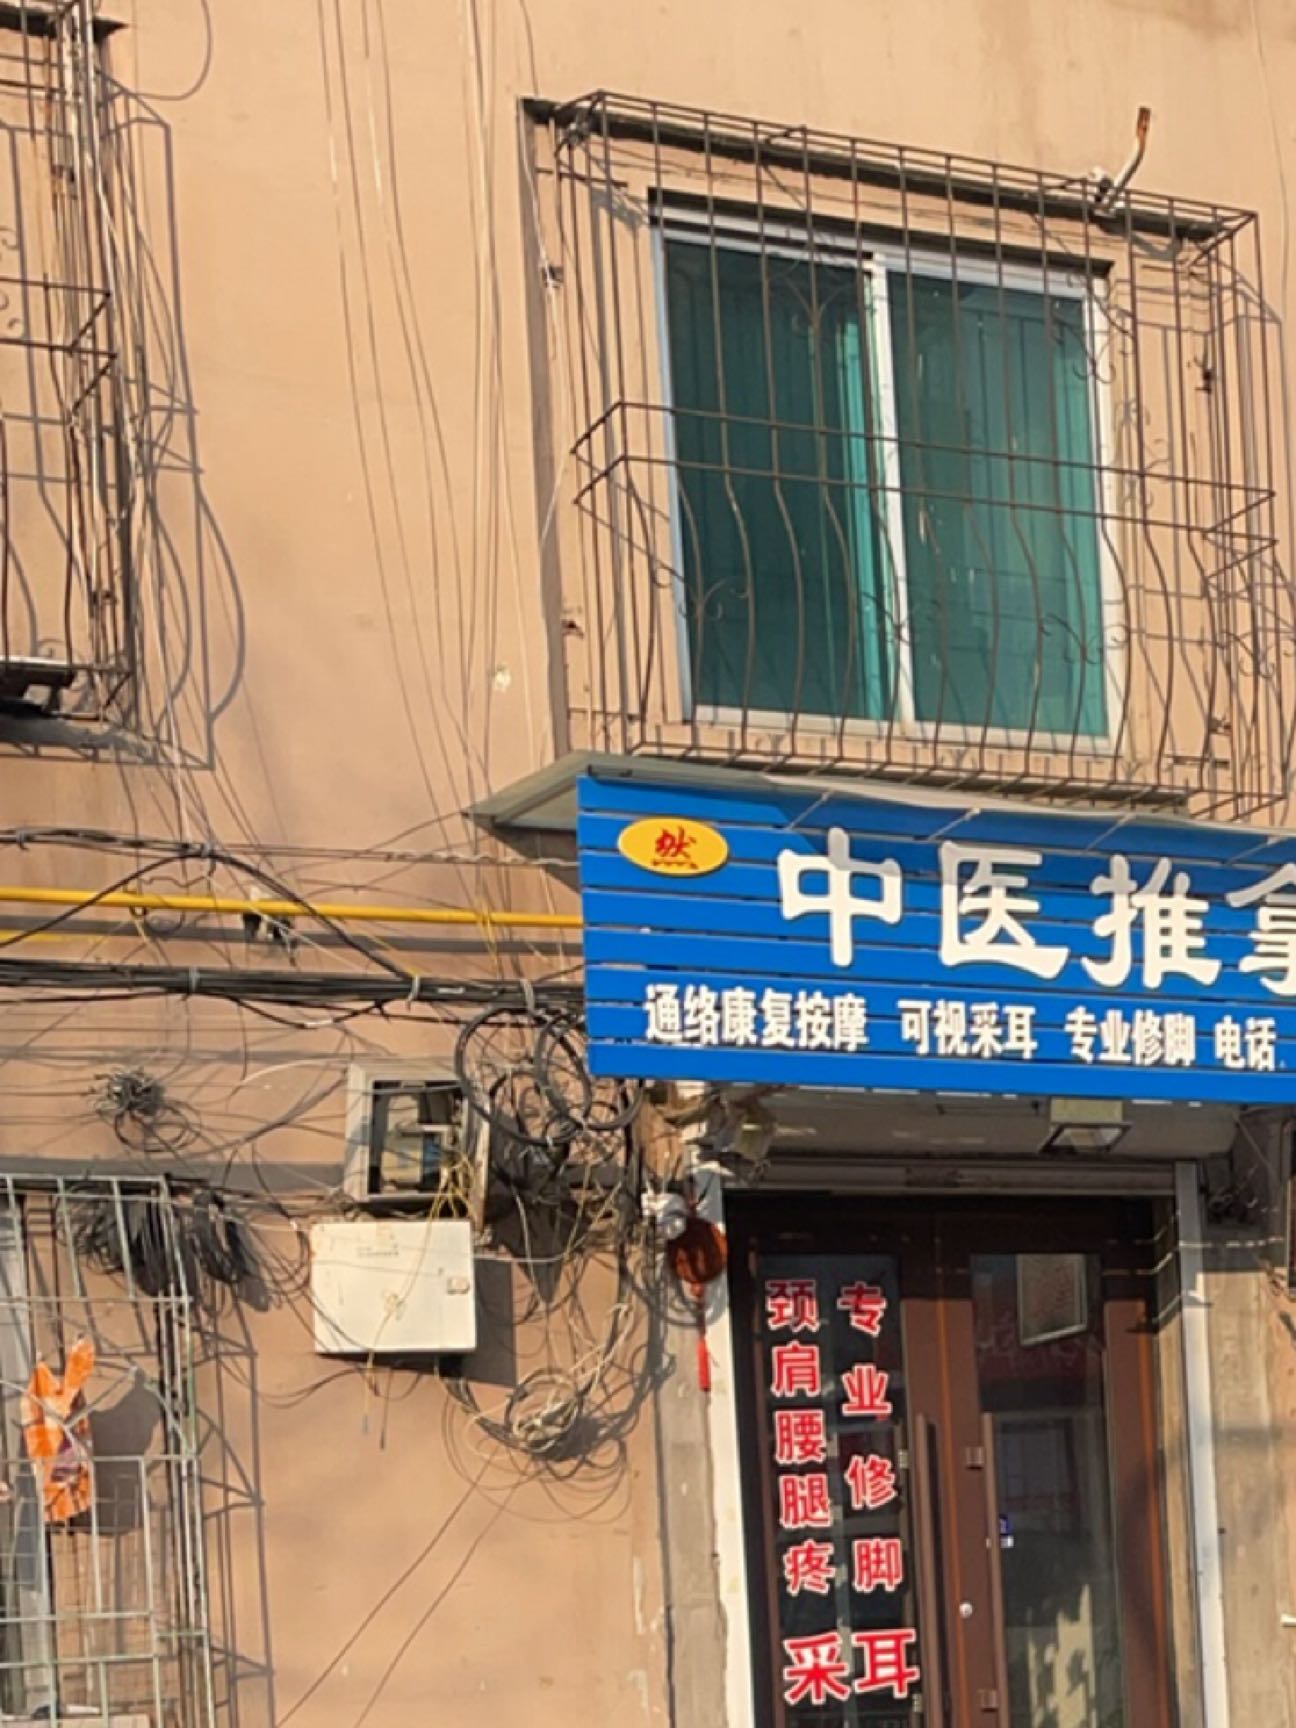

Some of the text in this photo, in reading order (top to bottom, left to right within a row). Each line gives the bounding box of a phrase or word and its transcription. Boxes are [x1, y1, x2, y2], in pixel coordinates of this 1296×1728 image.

[644, 983, 870, 1052] 通络康复按摩
[897, 999, 1038, 1060] 可视采耳
[1064, 1005, 1197, 1067] 专业修脚
[1214, 1014, 1277, 1072] 电话
[765, 1279, 836, 1595] 颈肩腰腿疼
[837, 1281, 903, 1592] 专业修脚
[783, 1628, 919, 1705] 采耳
